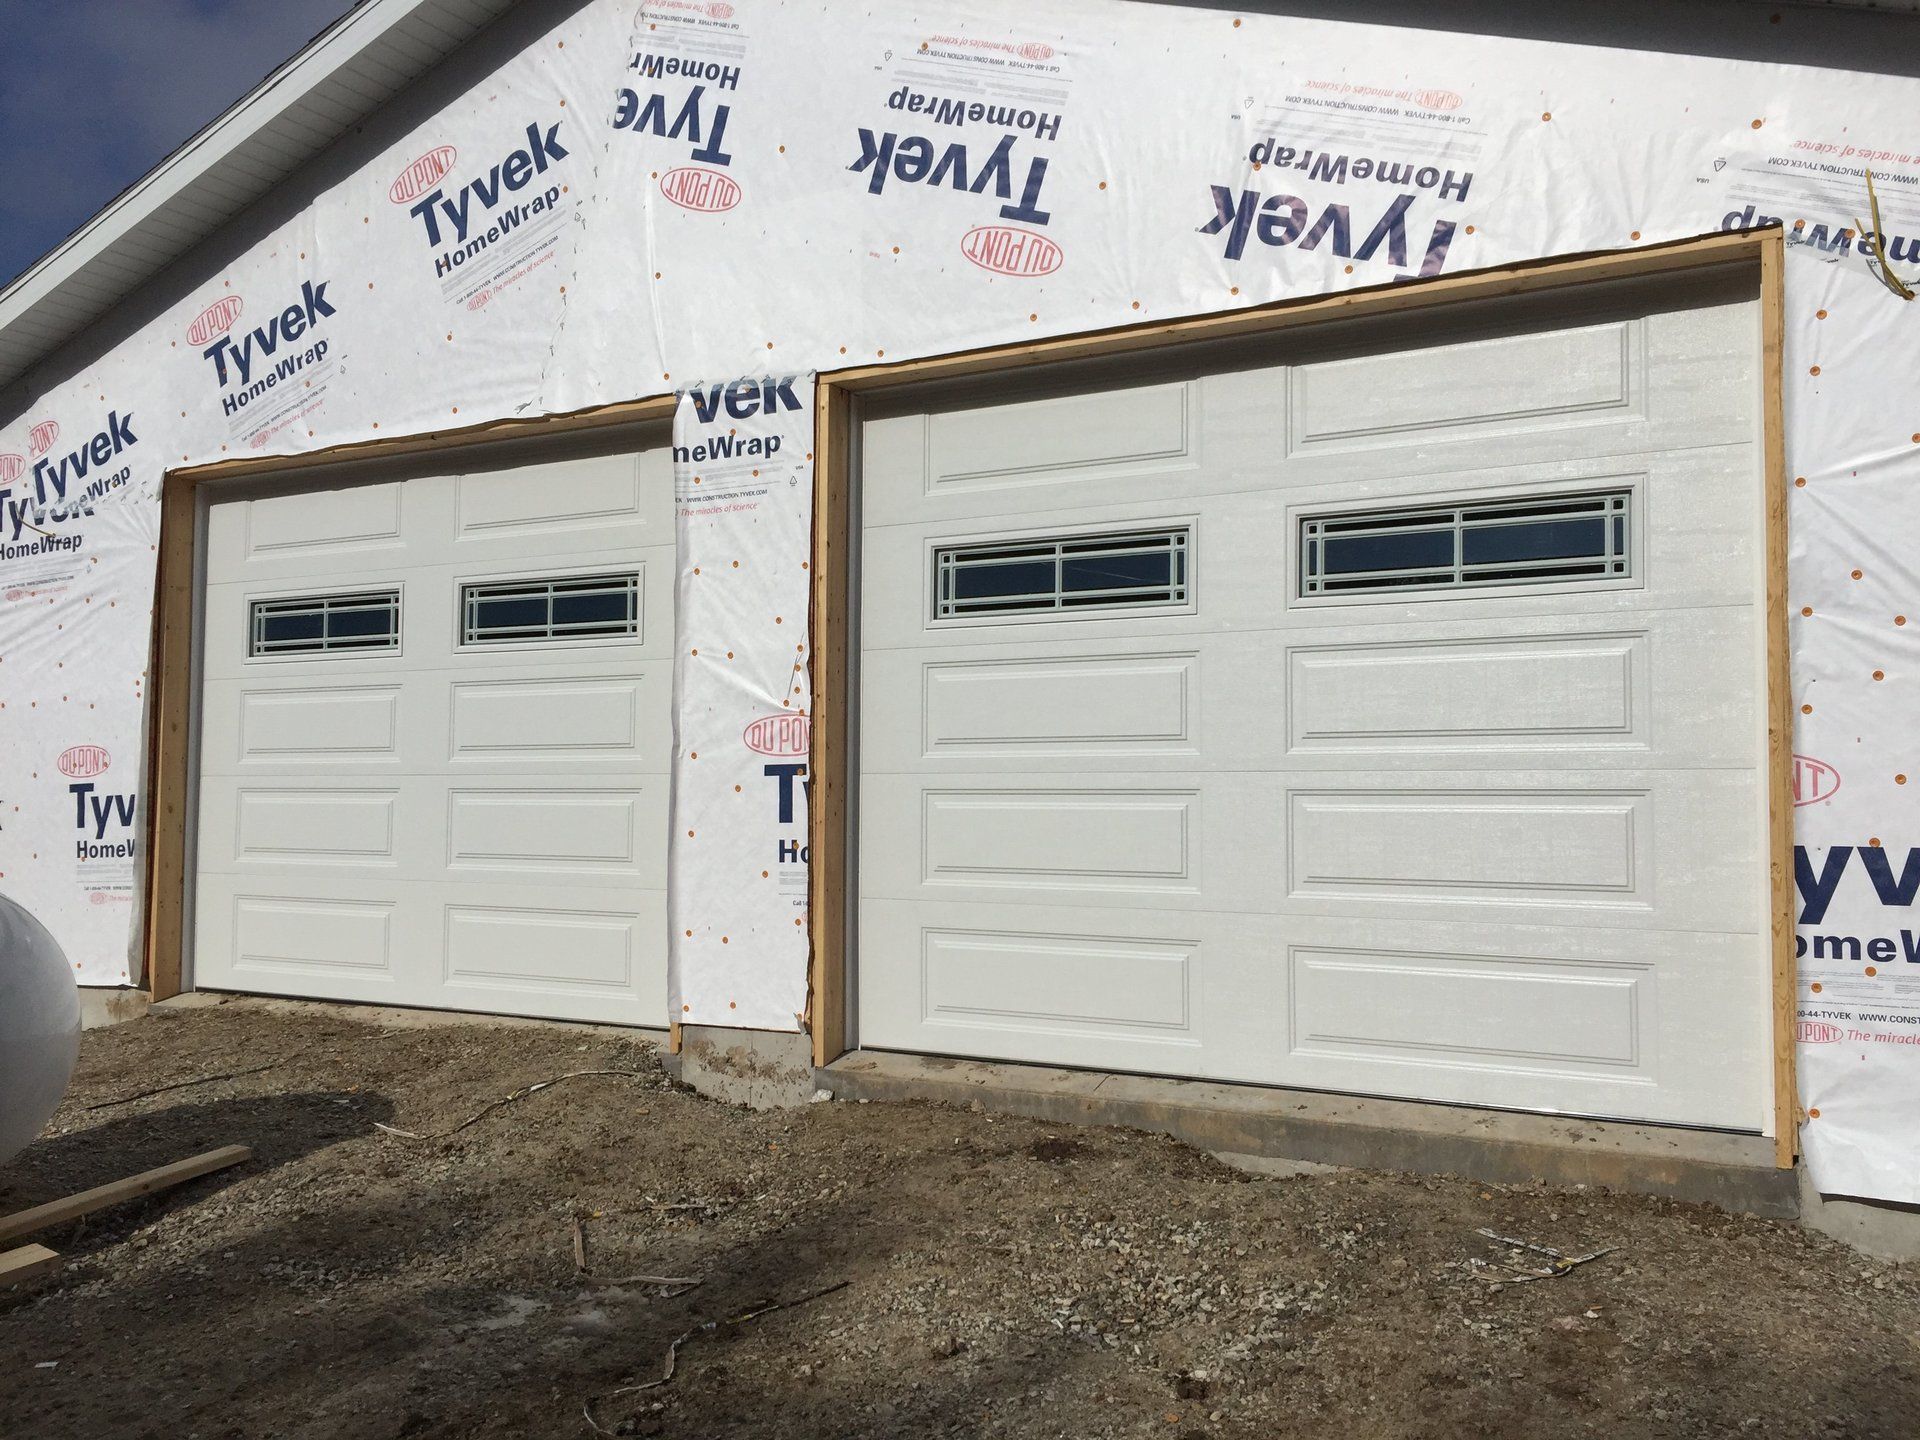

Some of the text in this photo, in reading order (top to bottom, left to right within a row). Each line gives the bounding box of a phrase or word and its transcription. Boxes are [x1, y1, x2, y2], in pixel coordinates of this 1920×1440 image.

[888, 86, 1062, 141] HomeWrap
[1793, 140, 1838, 154] science
[410, 121, 570, 248] Tyvek
[849, 128, 1051, 226] Tyvek
[1249, 138, 1474, 203] HomeWrap
[1840, 144, 1856, 158] of
[1856, 148, 1912, 163] miracles
[434, 186, 560, 279] HomeWrap
[1199, 184, 1458, 283] Tyvek
[203, 280, 337, 388] Tyvek
[222, 340, 328, 417] HomeWrap
[32, 410, 138, 506] Tyvek
[681, 508, 695, 517] The
[695, 504, 723, 515] miracles
[1847, 1029, 1871, 1042] The
